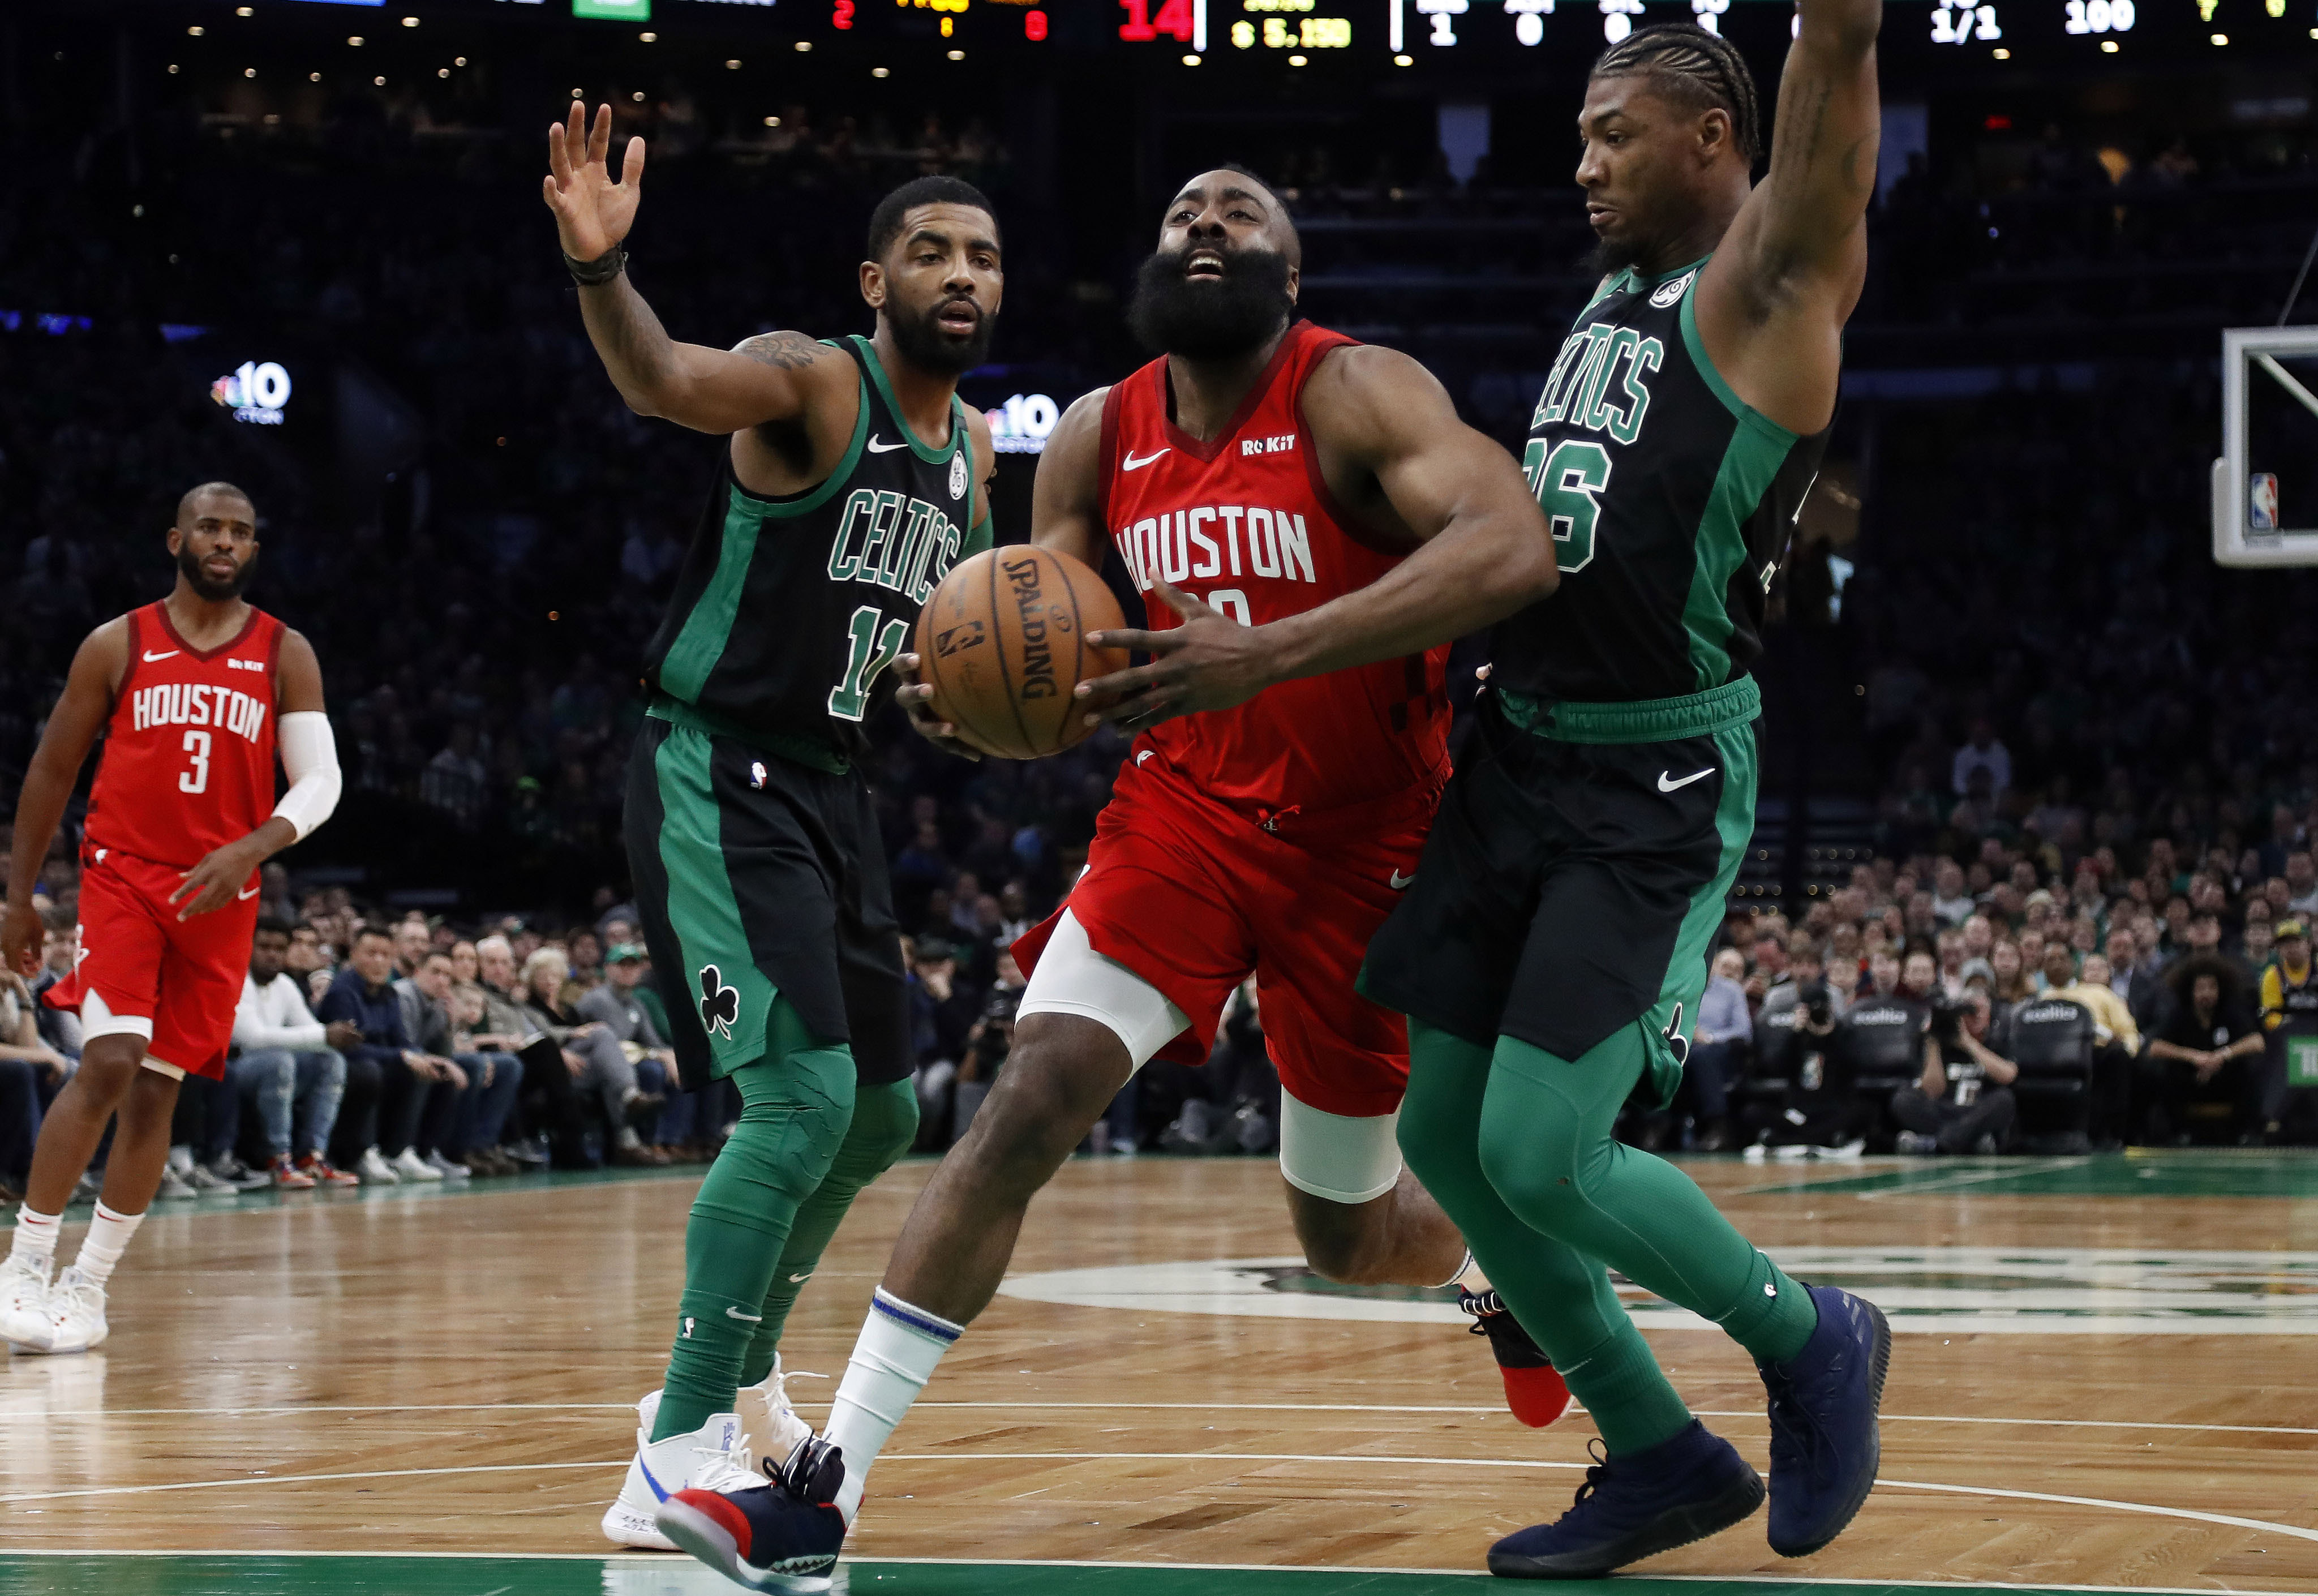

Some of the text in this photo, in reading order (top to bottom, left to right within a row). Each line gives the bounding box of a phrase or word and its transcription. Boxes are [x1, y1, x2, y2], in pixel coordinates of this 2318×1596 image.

[1119, 0, 1194, 41] 14
[1930, 5, 2002, 45] 1/1
[2066, 0, 2135, 34] 100
[234, 360, 293, 410] 10
[1002, 393, 1060, 439] 10
[827, 488, 961, 606] CELTICS
[1116, 505, 1317, 595] HOUSTON
[1002, 558, 1059, 700] SPALDING
[828, 605, 910, 722] 11
[133, 683, 267, 744] HOUSTON
[178, 730, 212, 795] 3
